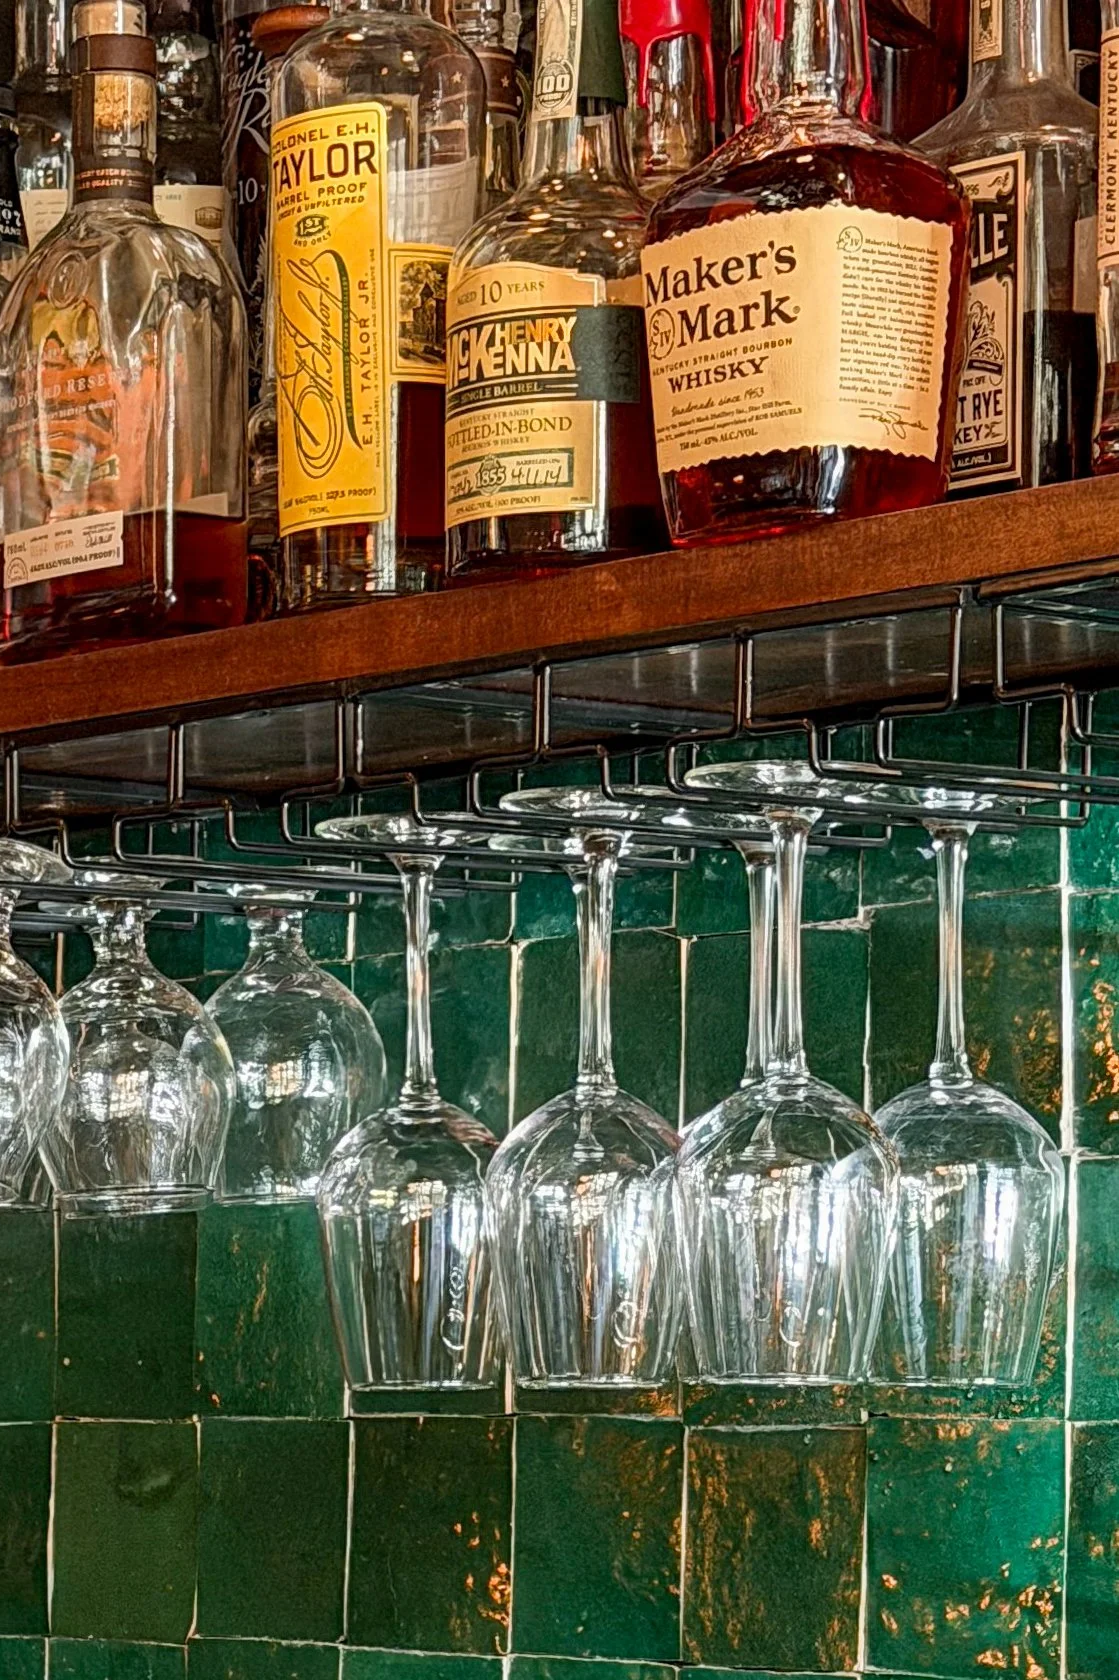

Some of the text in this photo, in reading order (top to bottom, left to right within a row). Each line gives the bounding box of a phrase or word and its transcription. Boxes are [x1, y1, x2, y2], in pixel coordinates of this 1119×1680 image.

[336, 121, 377, 137] E.H.
[1105, 49, 1119, 245] CLERMONT, KENTUCKY
[273, 140, 378, 197] TAYLOR
[305, 195, 365, 212] UNFILTERED
[317, 181, 368, 198] PROOF
[357, 272, 371, 306] JR.
[644, 240, 798, 308] Maker's
[479, 280, 503, 307] 10
[506, 280, 545, 295] YEARS
[495, 316, 578, 348] HENRY
[677, 289, 798, 349] Mark
[360, 316, 373, 392] TAYLOR
[692, 346, 738, 367] STRAIGHT
[742, 337, 793, 353] BOURBON
[493, 381, 543, 397] BARREL
[667, 356, 770, 394] WHISKY
[493, 407, 536, 419] STRAIGHT
[718, 395, 741, 406] since
[972, 389, 1004, 421] RYE
[446, 416, 573, 449] OTTLED-IN-BOND
[493, 435, 530, 447] WHISKEY
[476, 466, 506, 490] 1855
